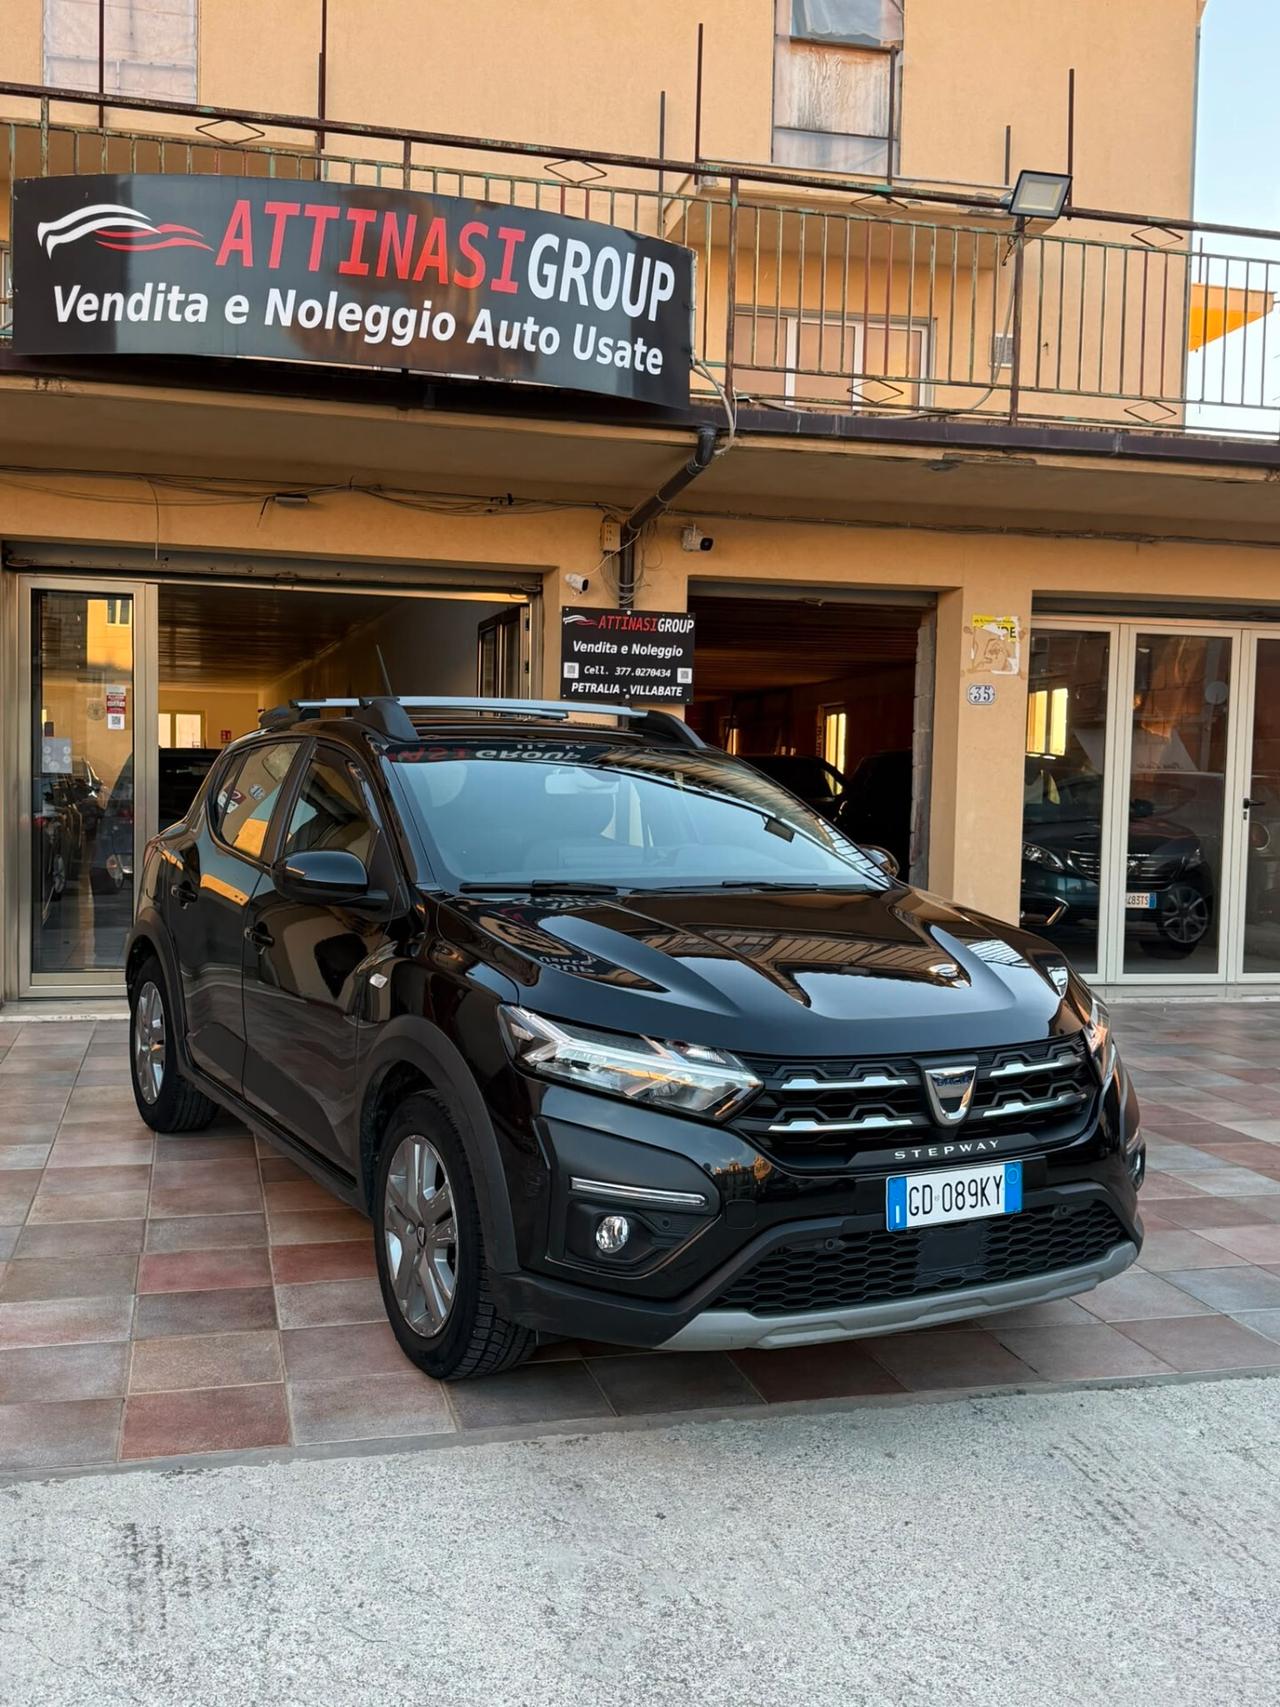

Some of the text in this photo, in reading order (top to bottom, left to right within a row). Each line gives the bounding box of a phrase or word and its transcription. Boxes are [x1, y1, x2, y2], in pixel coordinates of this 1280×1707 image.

[54, 282, 664, 375] Vendita e Noleggio Auto Usate
[572, 640, 684, 660] Vendita e Noleggio
[584, 665, 609, 675] Cell.
[571, 682, 620, 694] PETRALIA
[630, 685, 683, 696] VILLABATE
[973, 686, 992, 702] 35
[894, 1140, 999, 1160] STEPWAY
